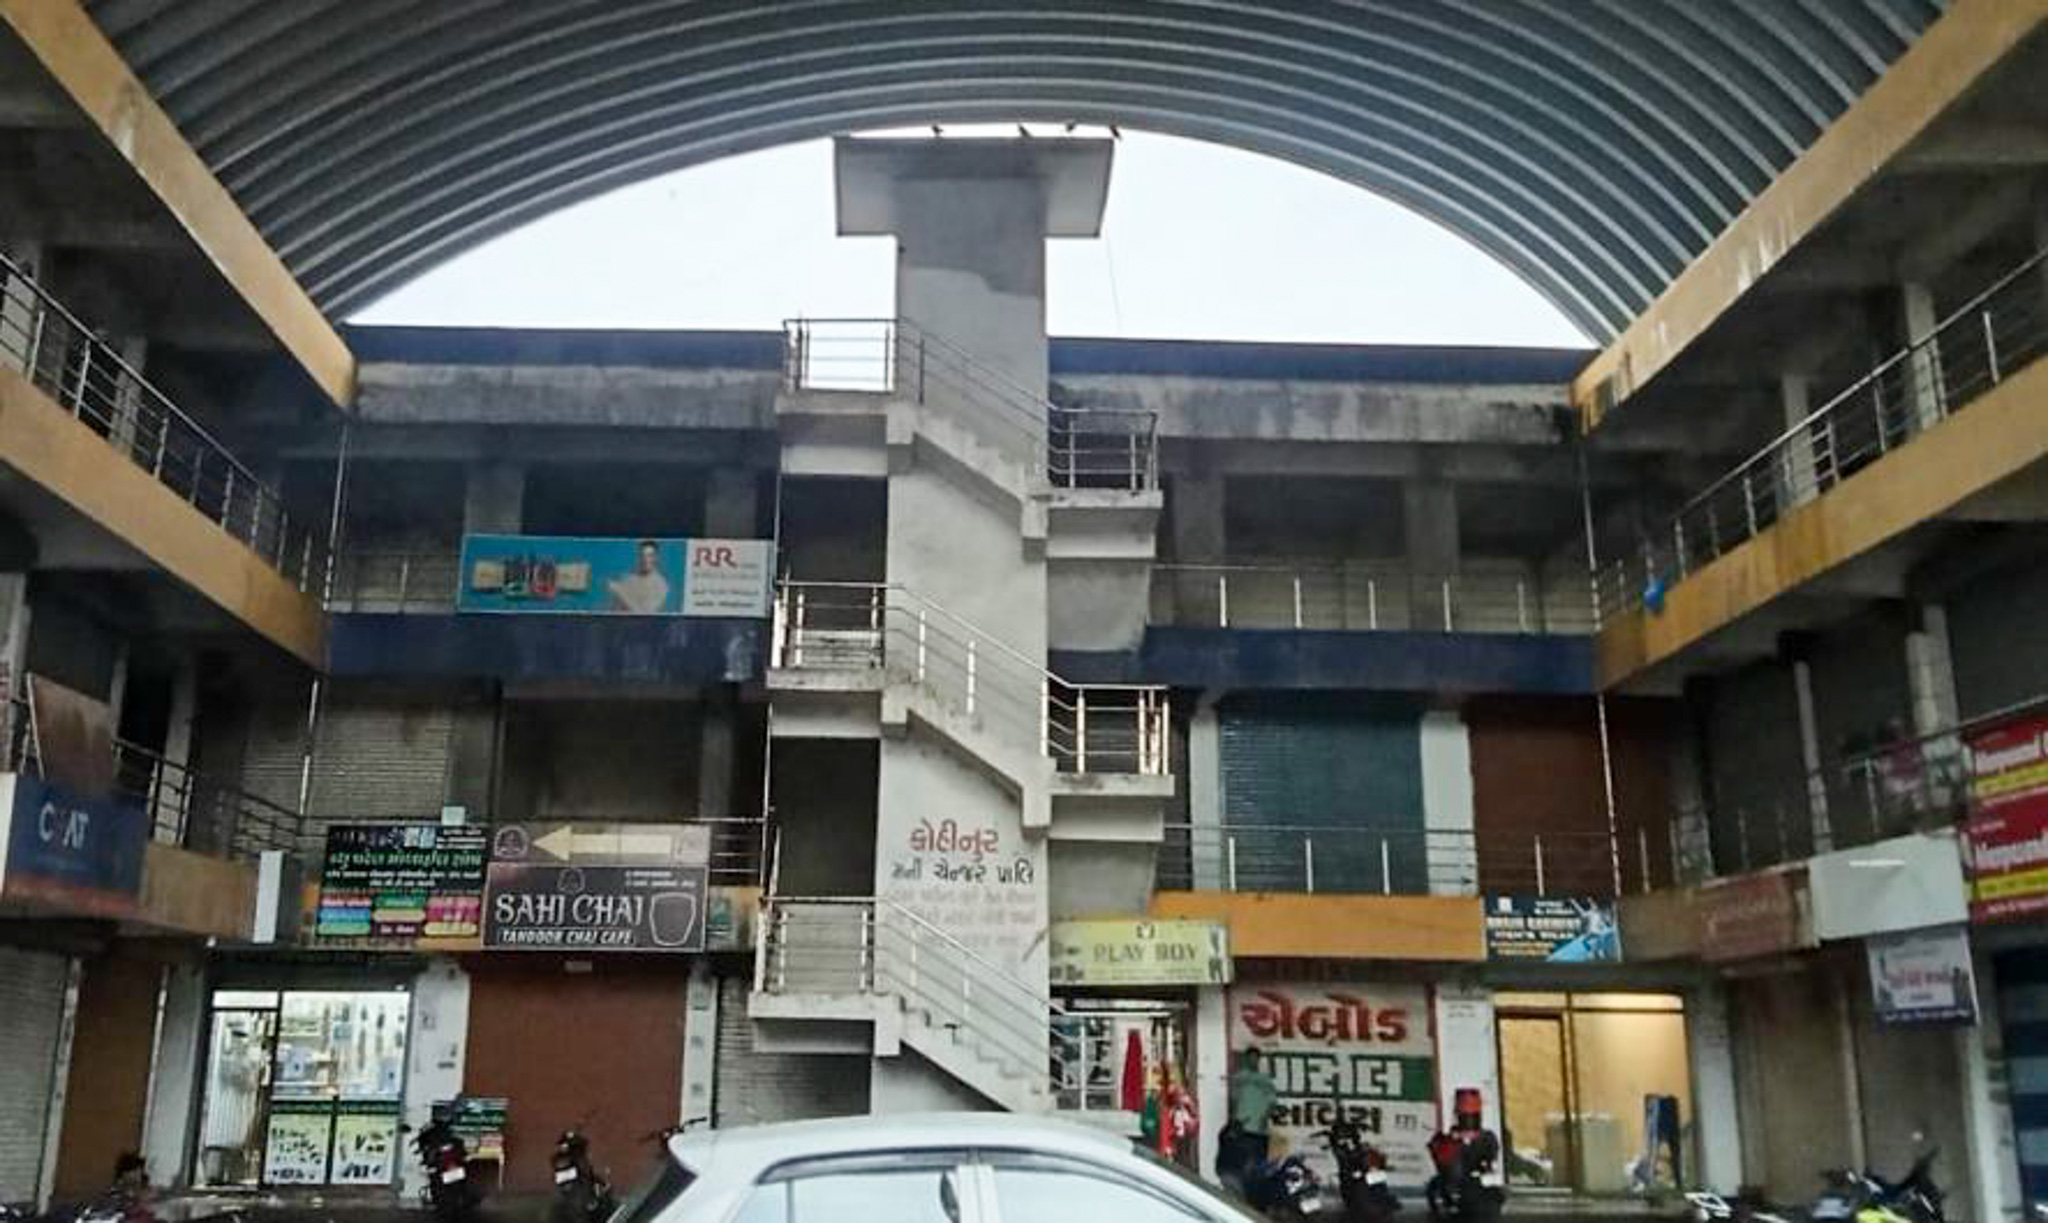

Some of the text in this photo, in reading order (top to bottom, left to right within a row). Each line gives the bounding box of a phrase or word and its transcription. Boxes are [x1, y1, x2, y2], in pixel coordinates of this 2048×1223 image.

[39, 801, 89, 849] CAT
[495, 893, 566, 926] SAHI
[572, 893, 644, 926] CHAI
[502, 930, 632, 945] TANDOOR CHAI CAFE
[1094, 943, 1198, 962] PLAY BOY
